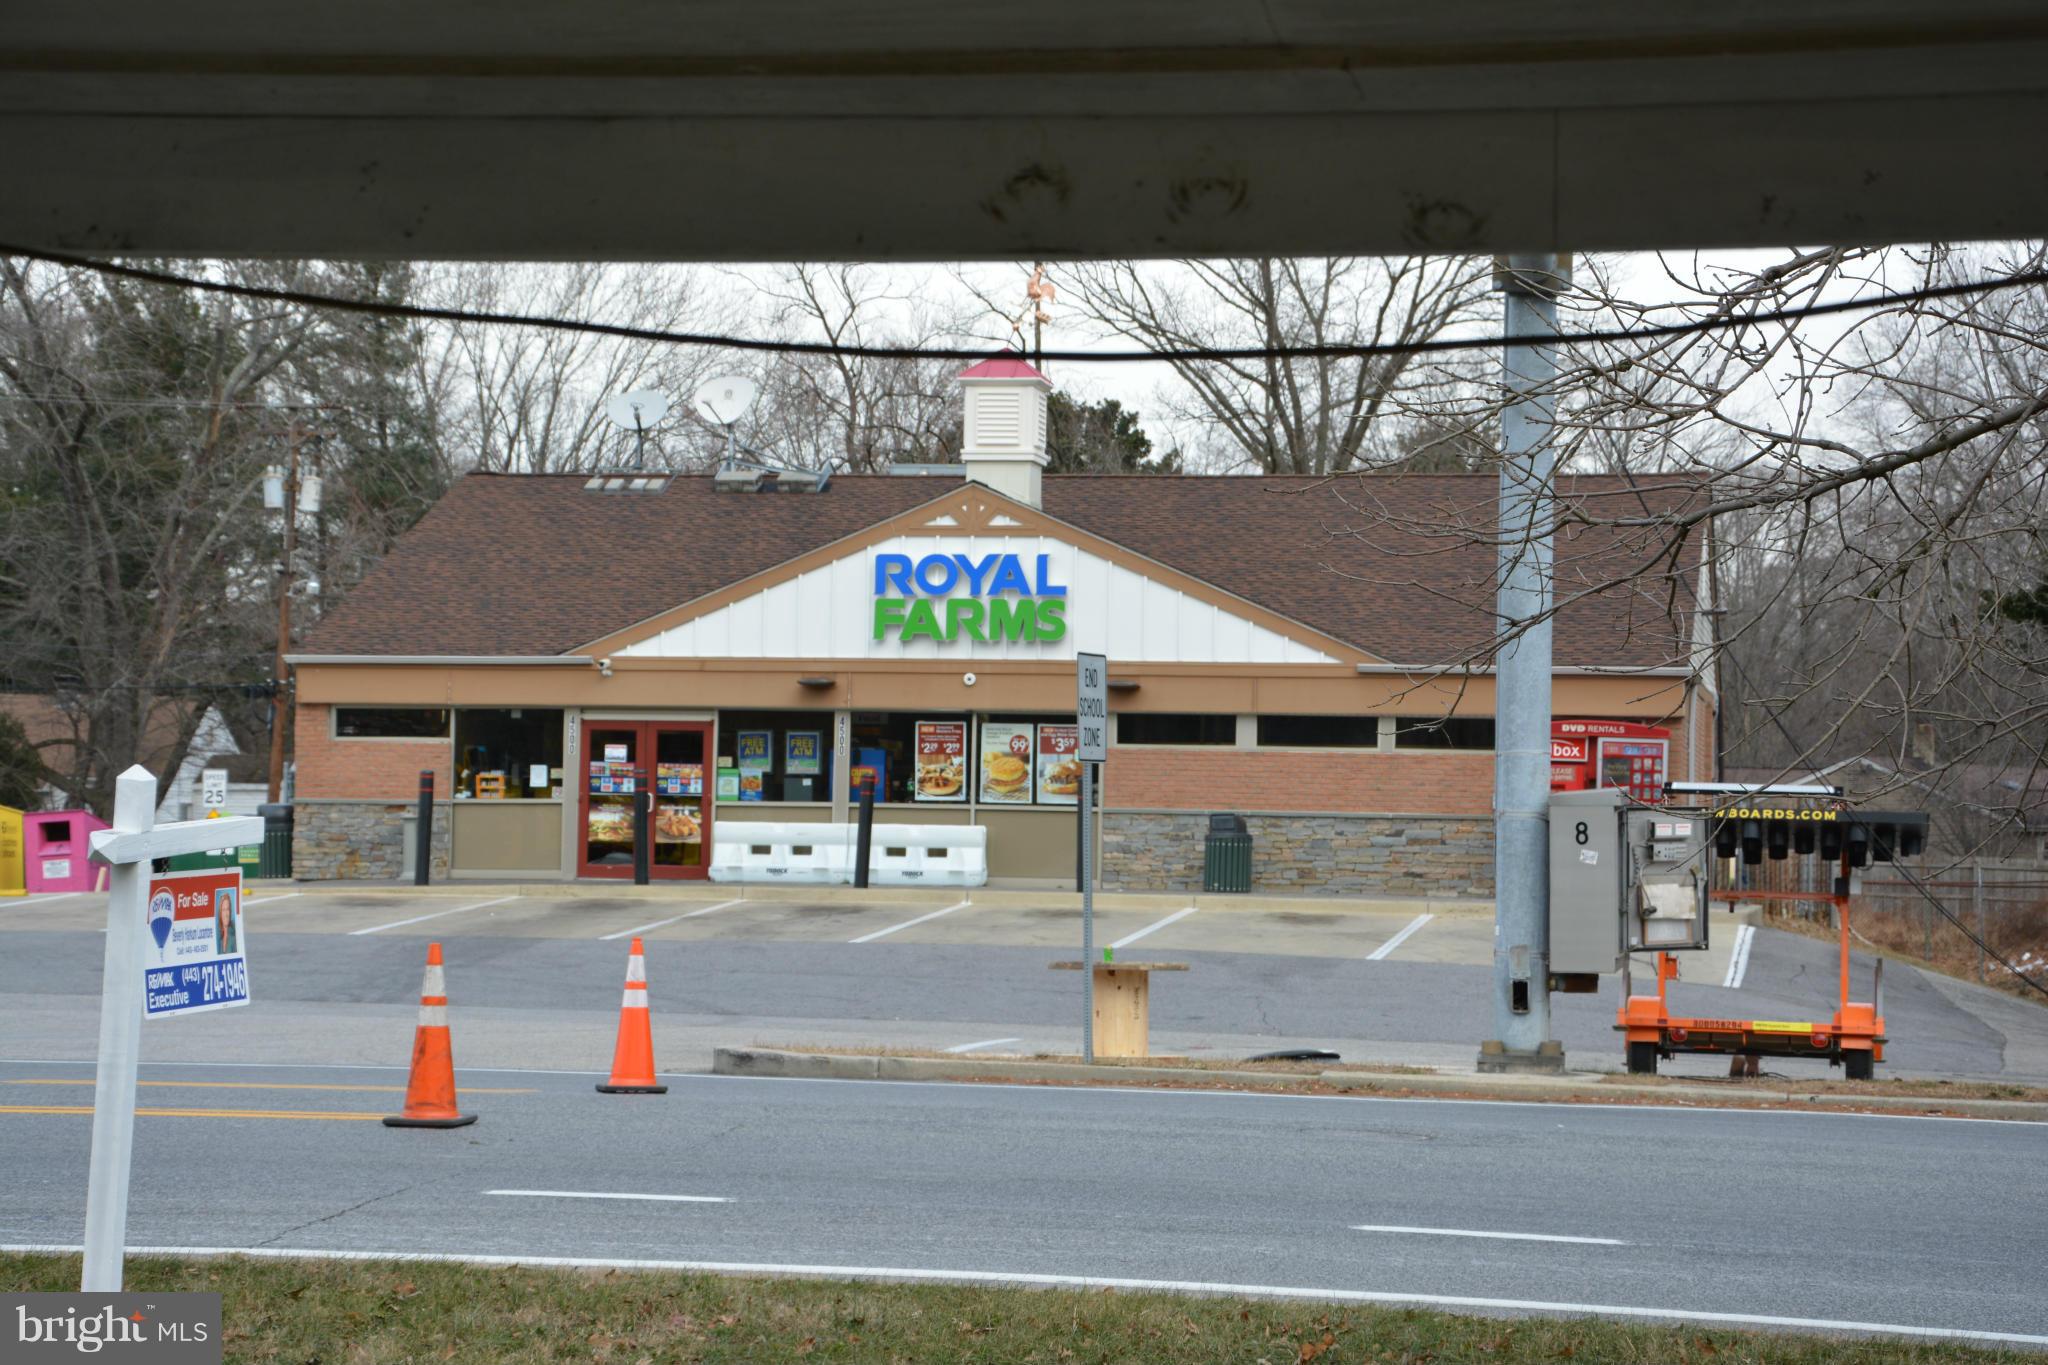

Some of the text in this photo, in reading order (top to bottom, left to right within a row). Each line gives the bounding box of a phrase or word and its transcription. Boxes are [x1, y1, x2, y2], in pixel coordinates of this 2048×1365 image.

[874, 553, 1068, 596] ROYAL
[873, 598, 1067, 642] FARMS
[1085, 668, 1098, 688] END
[1080, 697, 1104, 718] SCHOOL
[1083, 727, 1101, 747] ZONE
[1562, 724, 1625, 734] DVD RENTALS
[741, 736, 765, 747] FREE
[791, 737, 815, 748] FREE
[1553, 743, 1580, 757] box
[744, 747, 765, 756] ATM
[793, 747, 814, 756] ATM
[205, 790, 223, 804] 25
[1576, 822, 1588, 845] 8
[177, 891, 209, 909] For Sale
[181, 966, 200, 987] (443)
[202, 961, 246, 1001] 274-1946
[149, 989, 190, 1009] Executive
